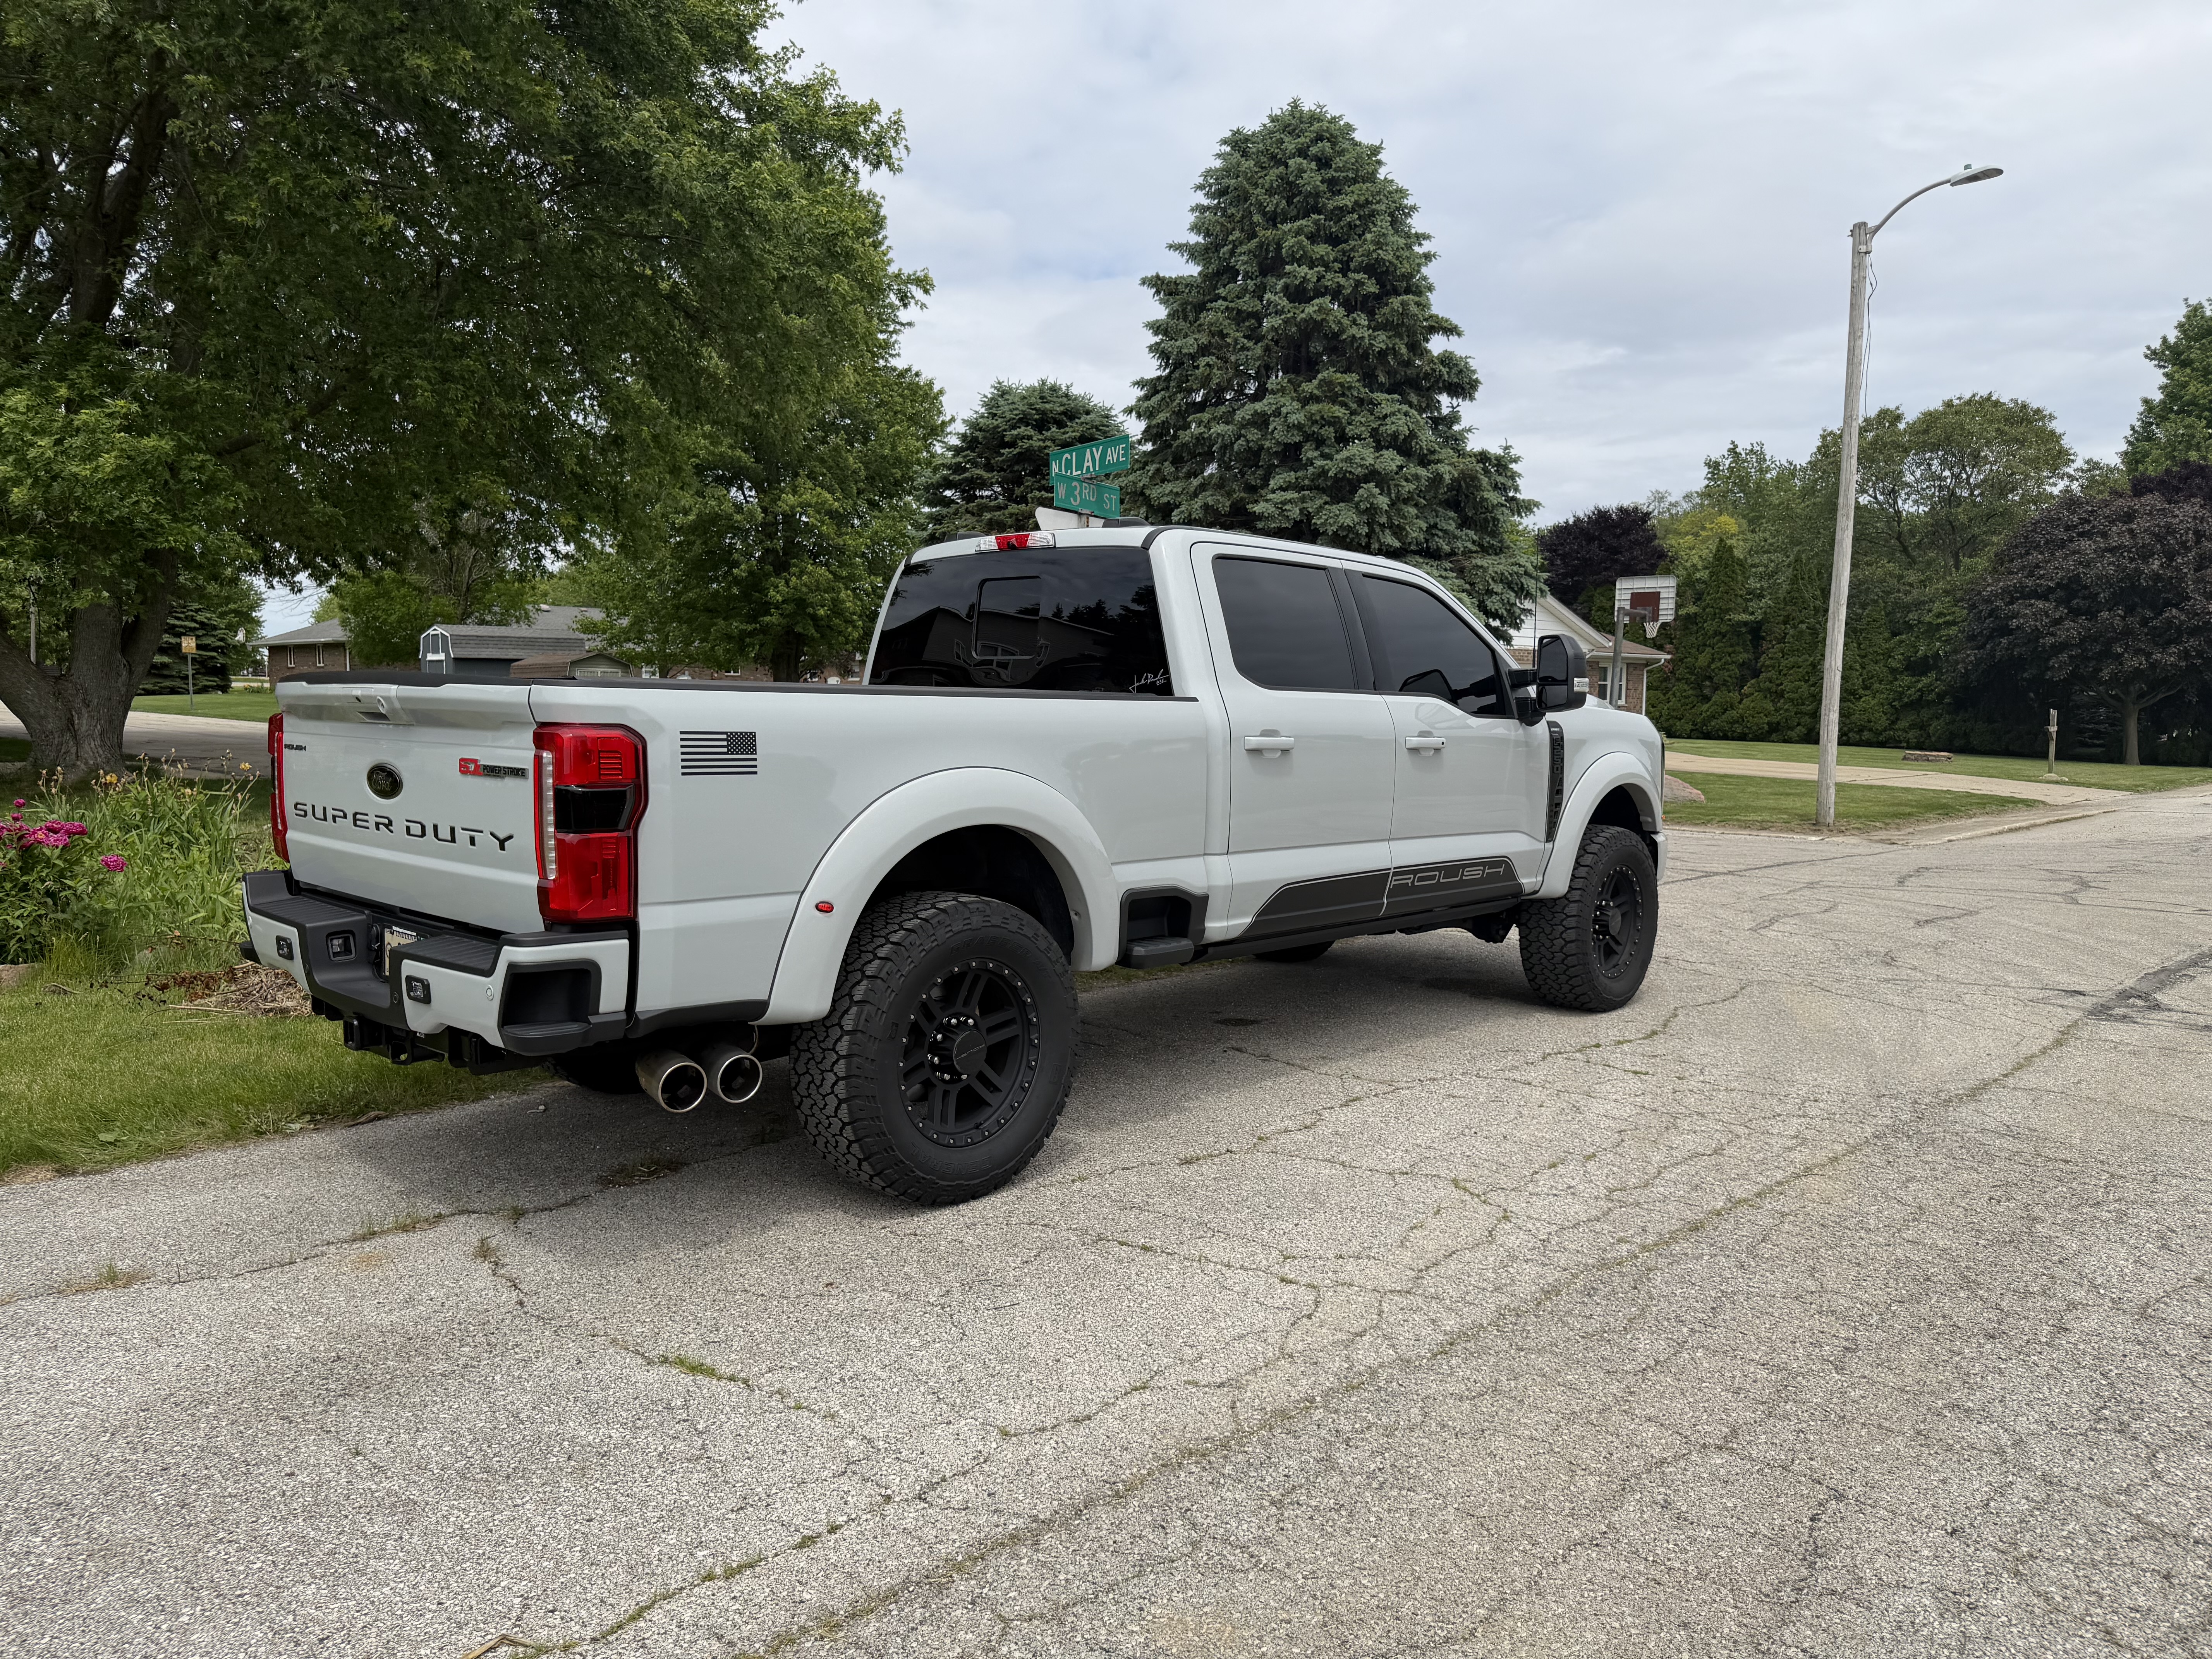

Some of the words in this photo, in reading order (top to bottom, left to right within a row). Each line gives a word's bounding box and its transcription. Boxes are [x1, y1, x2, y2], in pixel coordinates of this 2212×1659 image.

[1052, 460, 1059, 477] N
[1062, 446, 1103, 476] CLAY
[1106, 444, 1126, 464] AVE
[1058, 482, 1066, 499] W
[1070, 482, 1097, 506] 3RD
[1103, 494, 1116, 511] ST
[372, 770, 392, 791] Ford
[483, 764, 502, 774] POWER
[503, 767, 526, 777] STROKE
[294, 802, 394, 834] SUPER
[405, 818, 514, 852] DUTY
[1390, 864, 1505, 888] ROUSH
